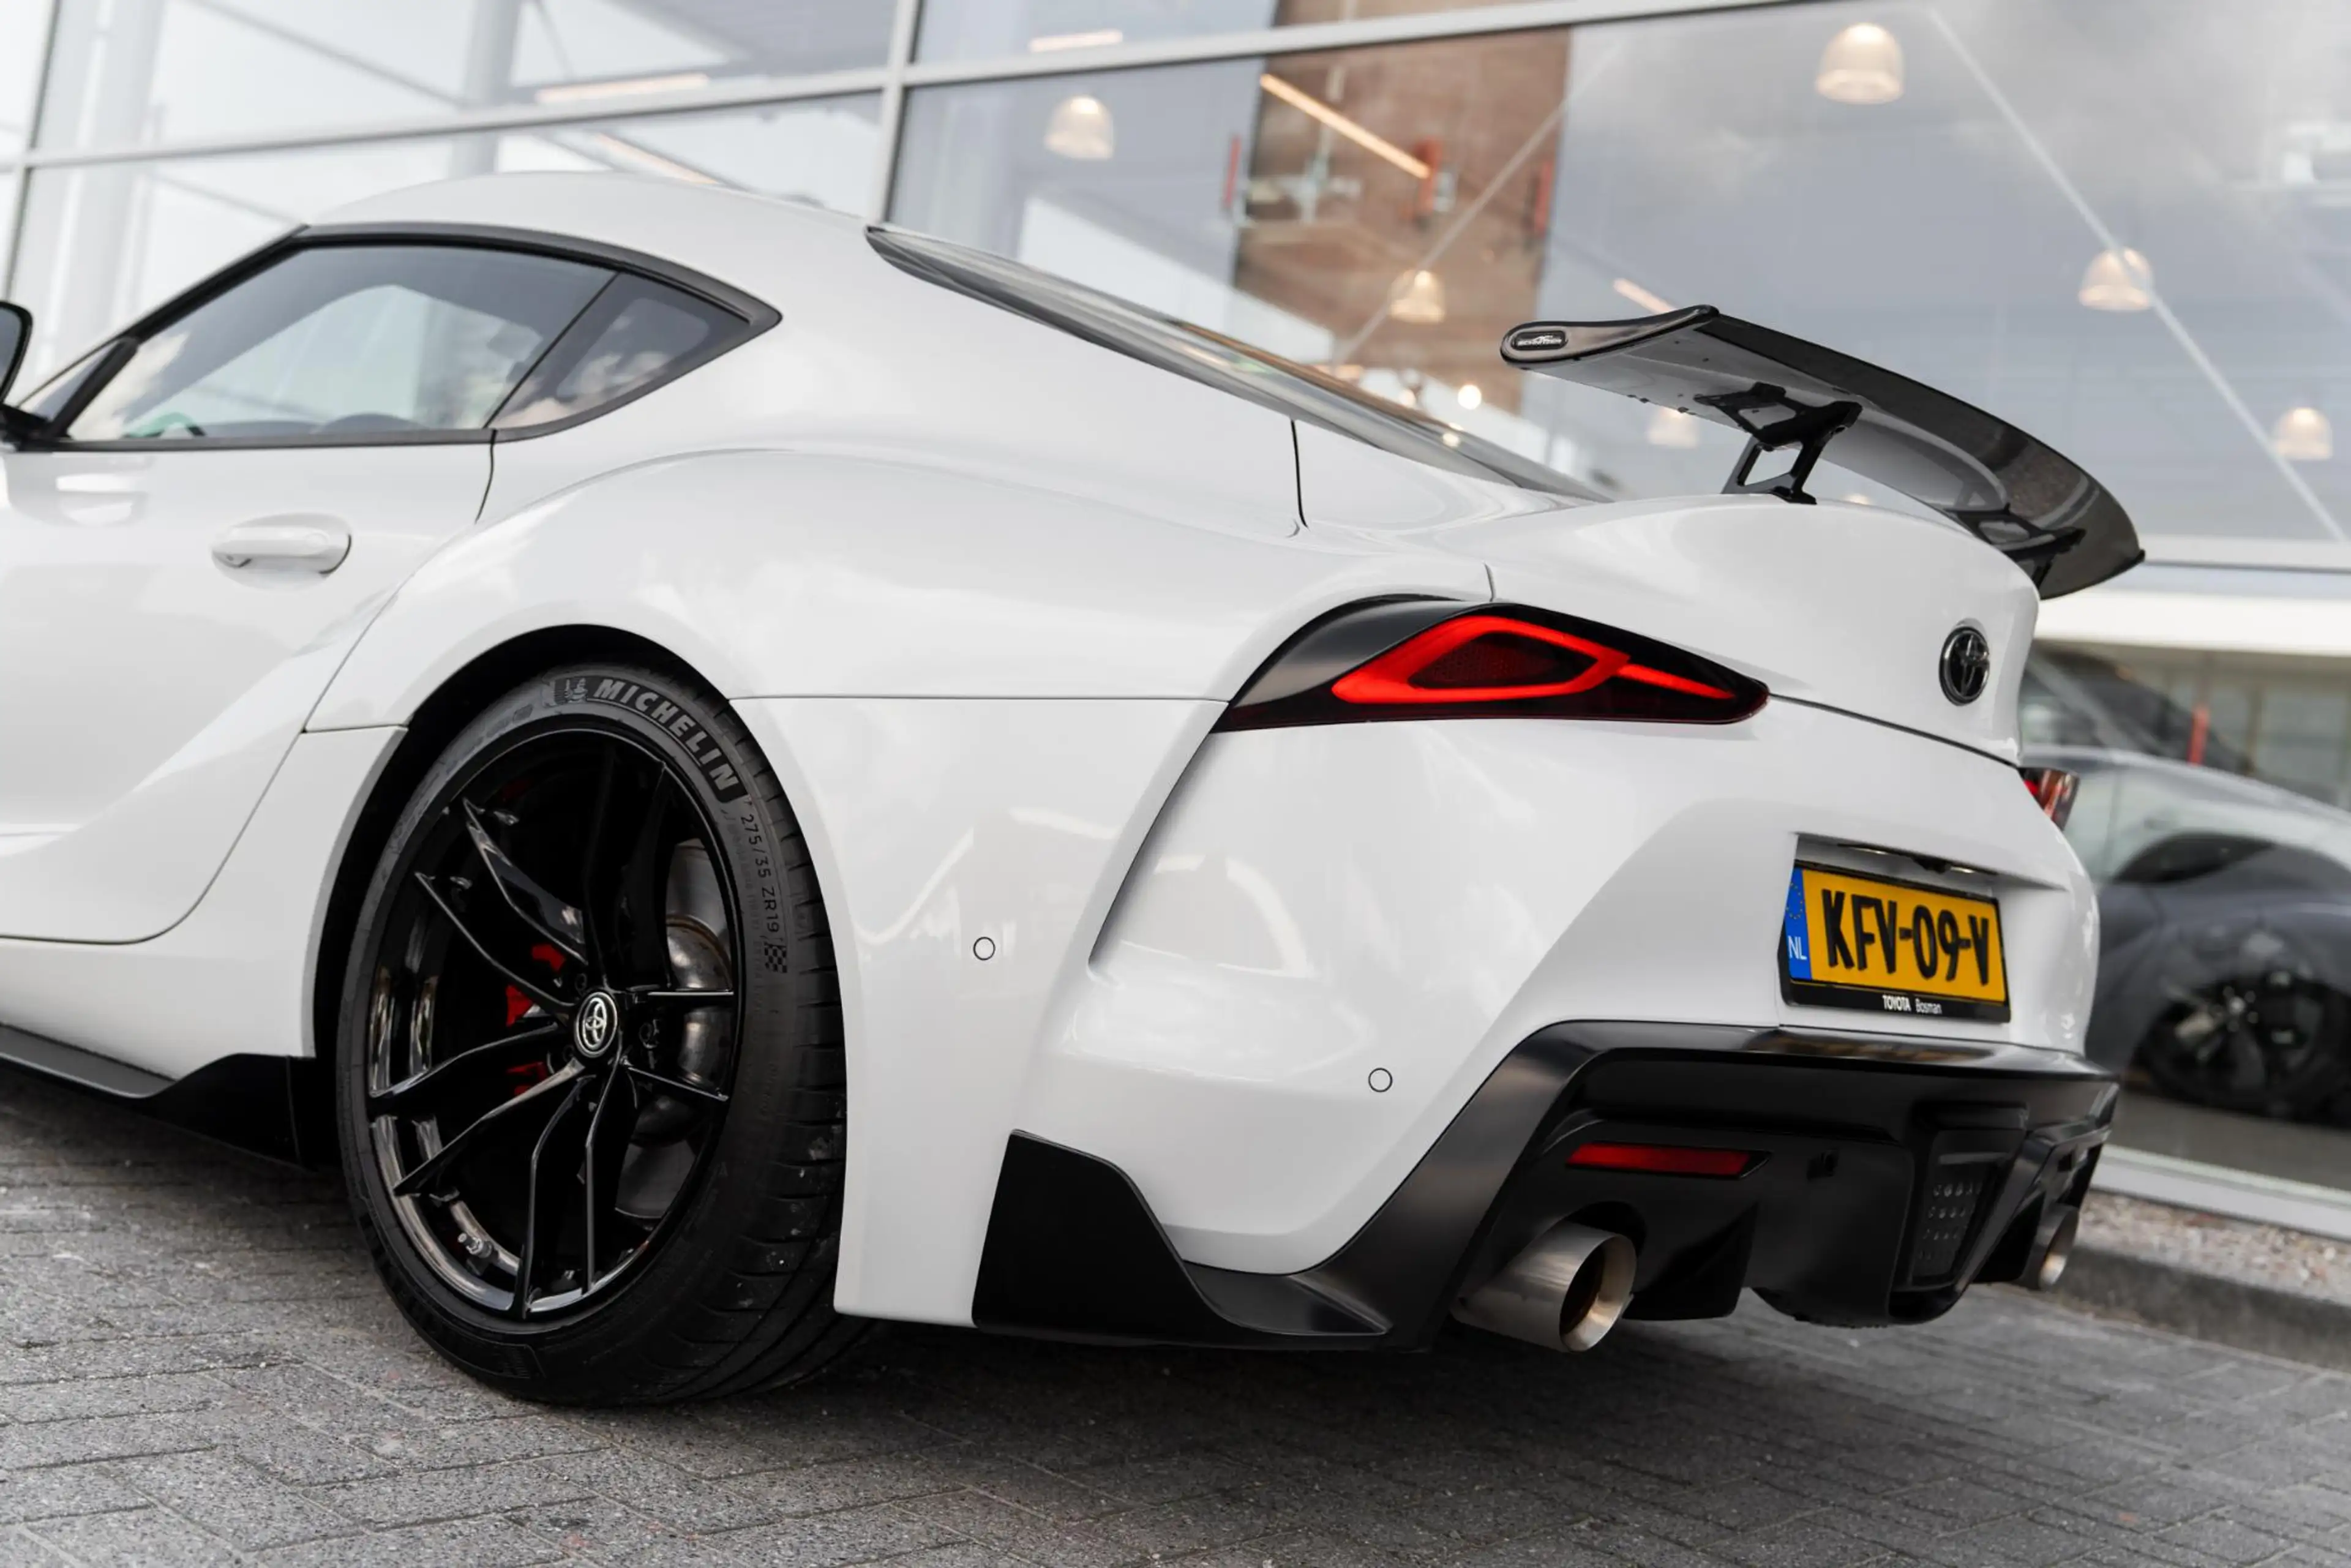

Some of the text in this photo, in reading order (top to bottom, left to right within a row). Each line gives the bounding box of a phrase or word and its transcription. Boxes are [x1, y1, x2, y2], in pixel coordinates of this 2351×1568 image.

[593, 678, 740, 792] MICHELIN
[741, 814, 771, 879] 275/35
[761, 885, 781, 933] ZR19
[1788, 936, 1807, 961] NL
[1882, 994, 1942, 1014] TOYOTA Bosman
